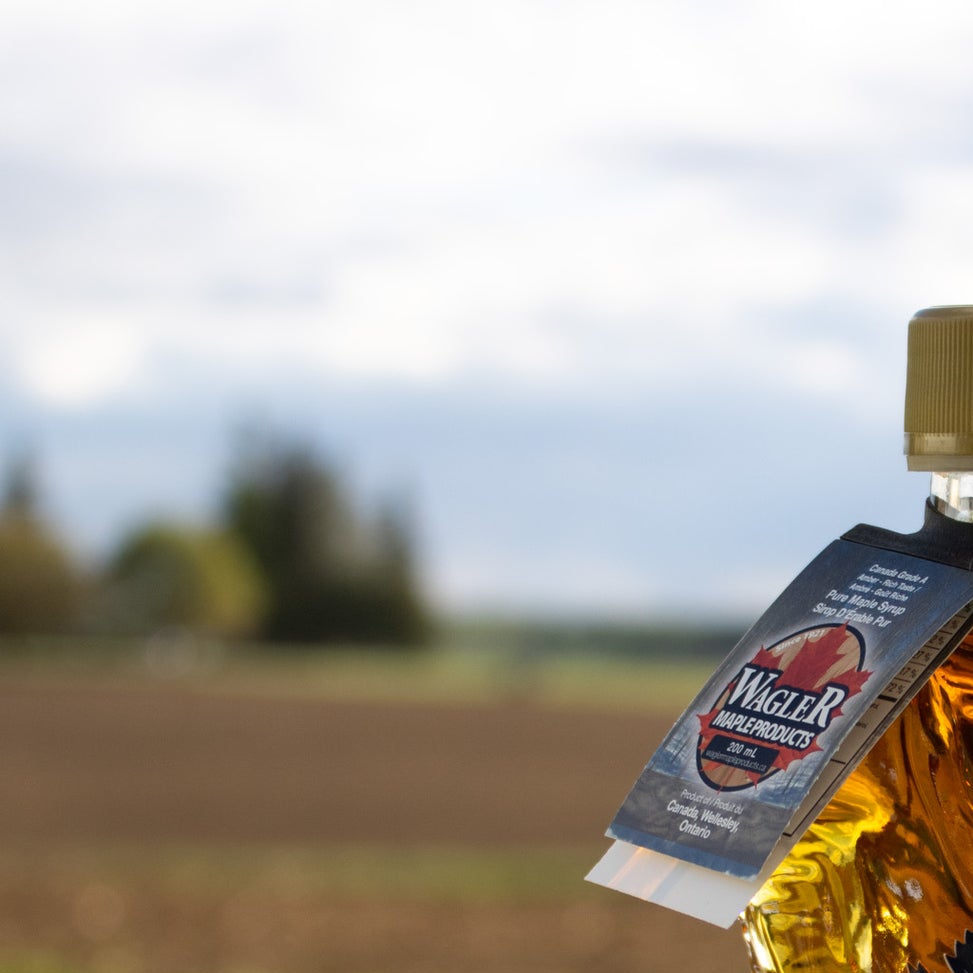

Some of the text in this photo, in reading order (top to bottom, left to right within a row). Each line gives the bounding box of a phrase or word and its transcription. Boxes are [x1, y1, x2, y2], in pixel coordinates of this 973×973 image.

[857, 573, 880, 583] Amber
[882, 579, 898, 588] Rich
[869, 564, 929, 584] Canada Grade A
[825, 589, 906, 616] Pure Maple Syrup
[812, 602, 837, 617] Sirop
[872, 616, 892, 628] Pur
[728, 667, 845, 728] WAGLER
[726, 742, 758, 758] 200 mL
[666, 799, 740, 834] Canada, Wellesley,
[679, 819, 711, 839] Ontario
